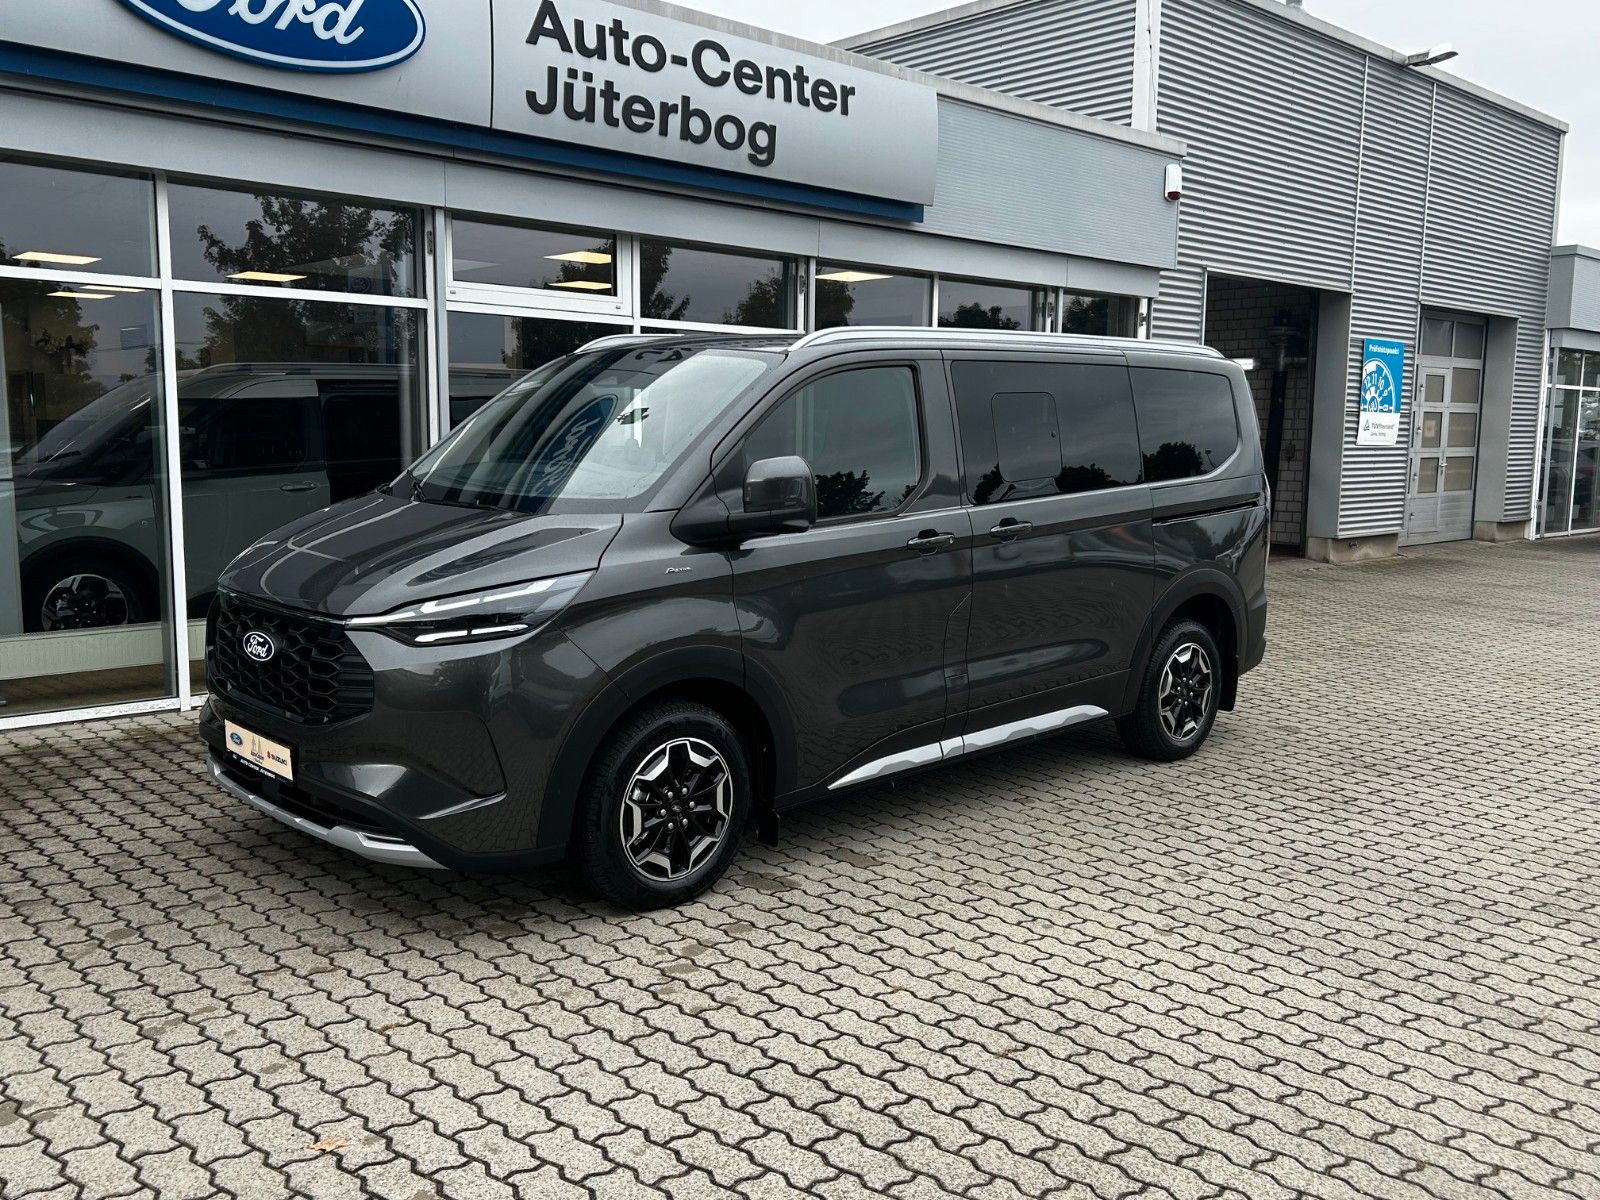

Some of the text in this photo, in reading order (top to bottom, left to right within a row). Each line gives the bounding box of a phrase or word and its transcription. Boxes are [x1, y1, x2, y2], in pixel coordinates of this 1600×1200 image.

[525, 0, 856, 116] Auto-Center
[525, 65, 777, 167] Jüterbog
[247, 634, 269, 658] Ford
